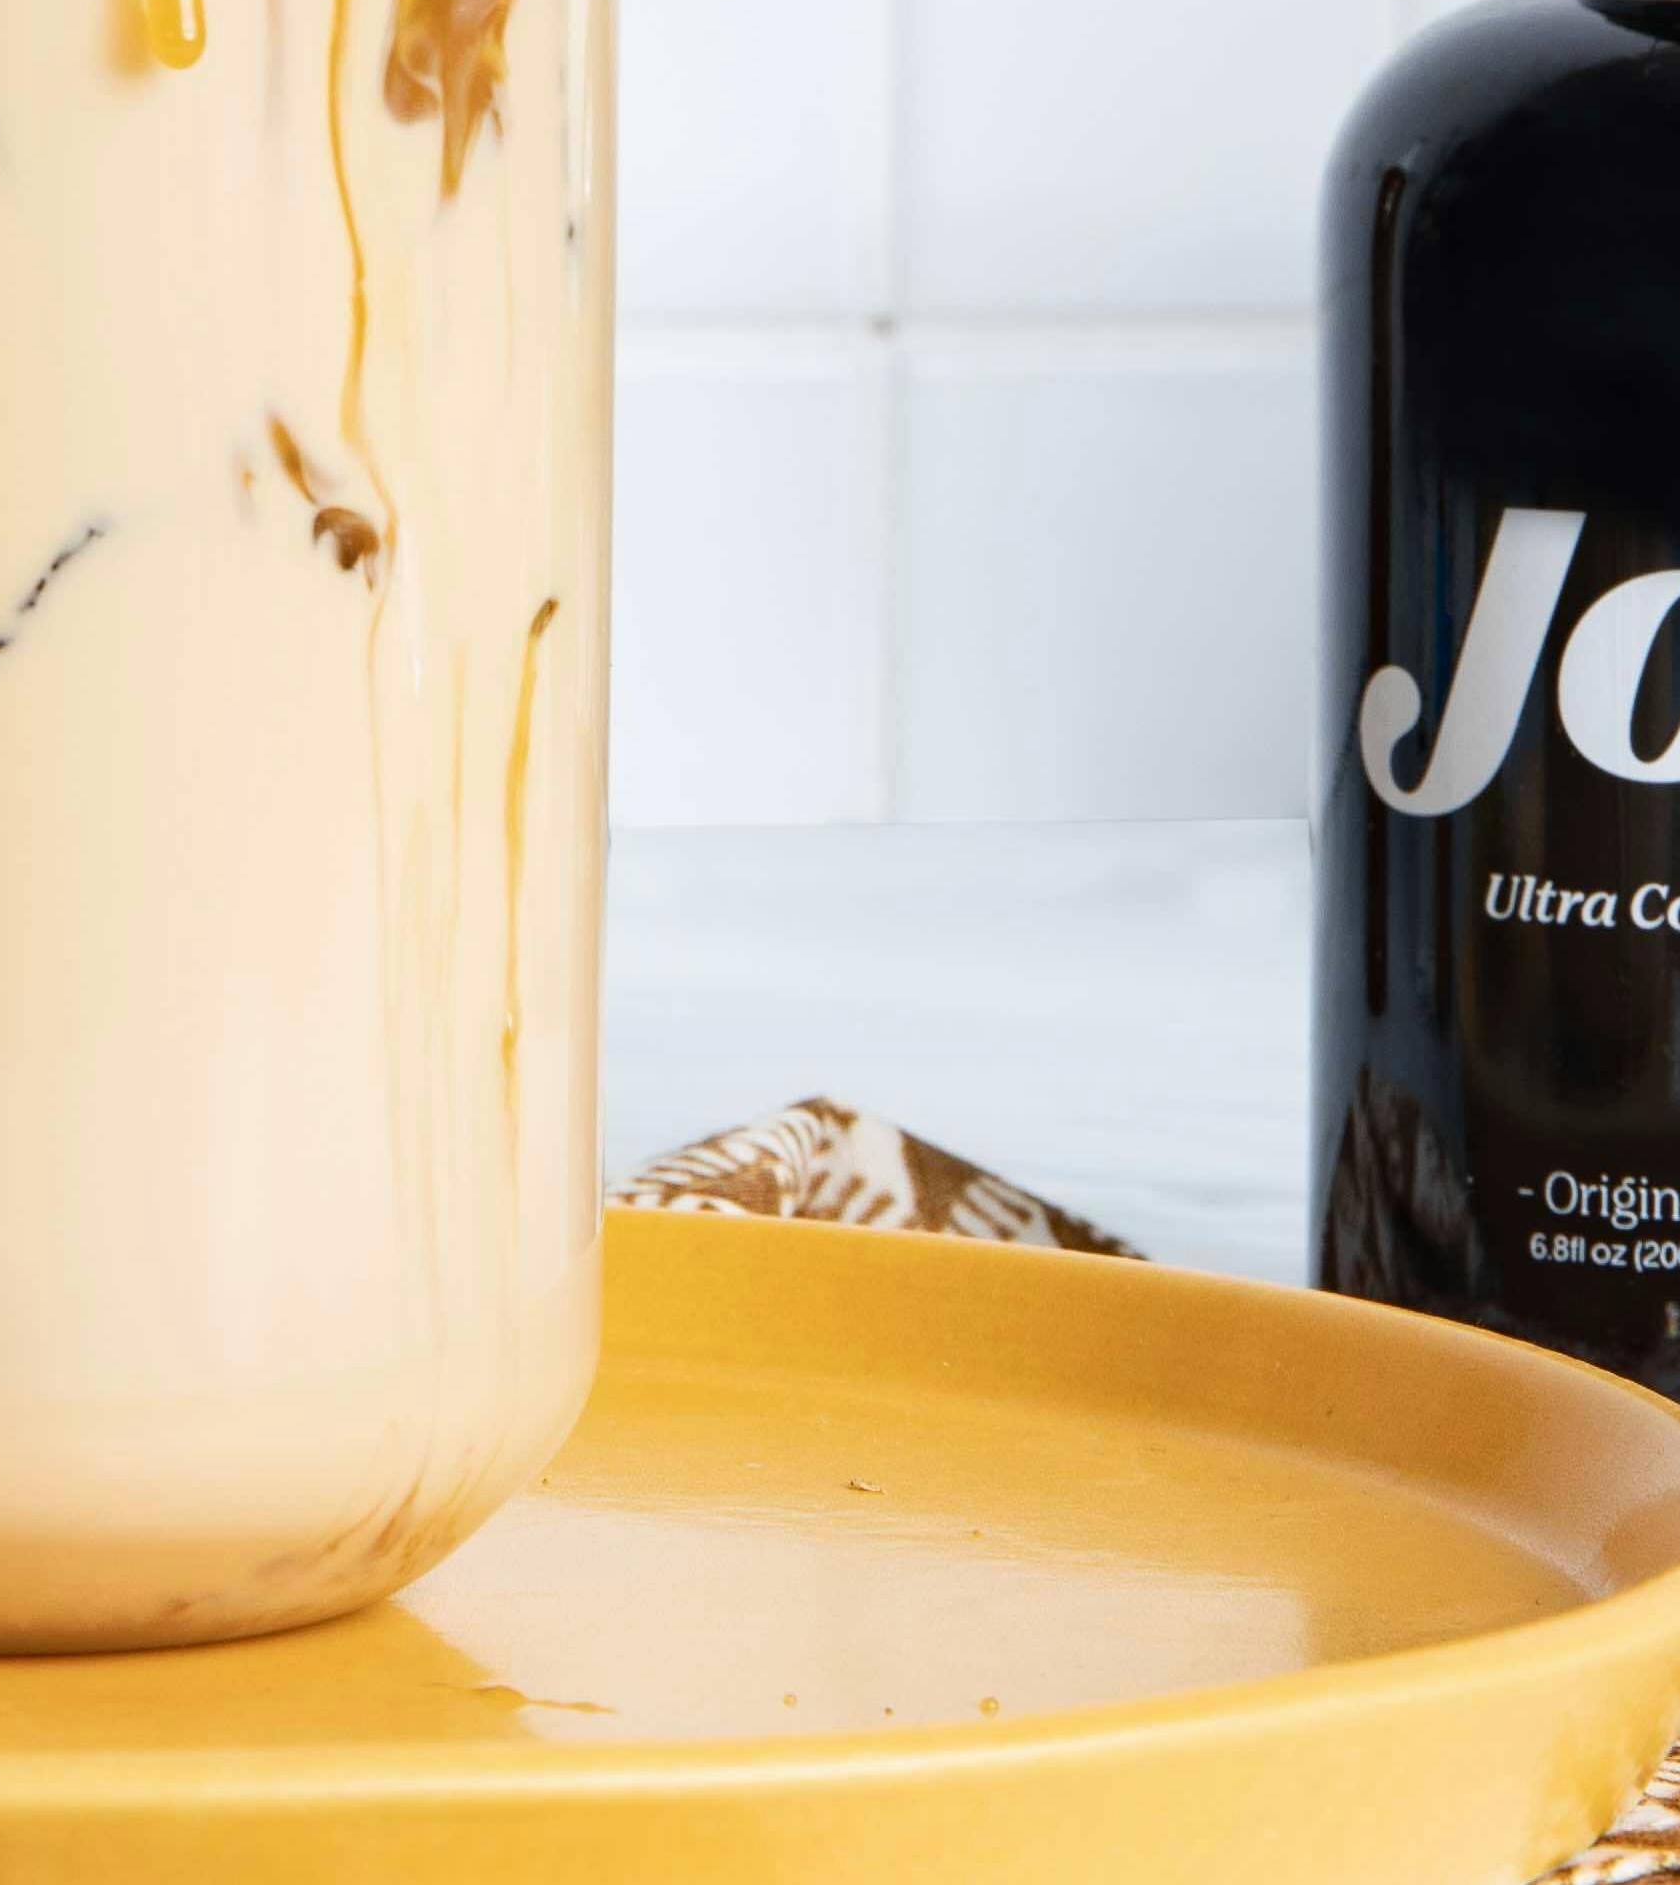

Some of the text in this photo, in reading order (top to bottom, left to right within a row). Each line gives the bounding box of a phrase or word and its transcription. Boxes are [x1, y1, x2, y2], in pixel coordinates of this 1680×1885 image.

[1484, 872, 1618, 928] Ultra
[1529, 1231, 1587, 1264] 6.8fl
[1590, 1241, 1628, 1267] oz
